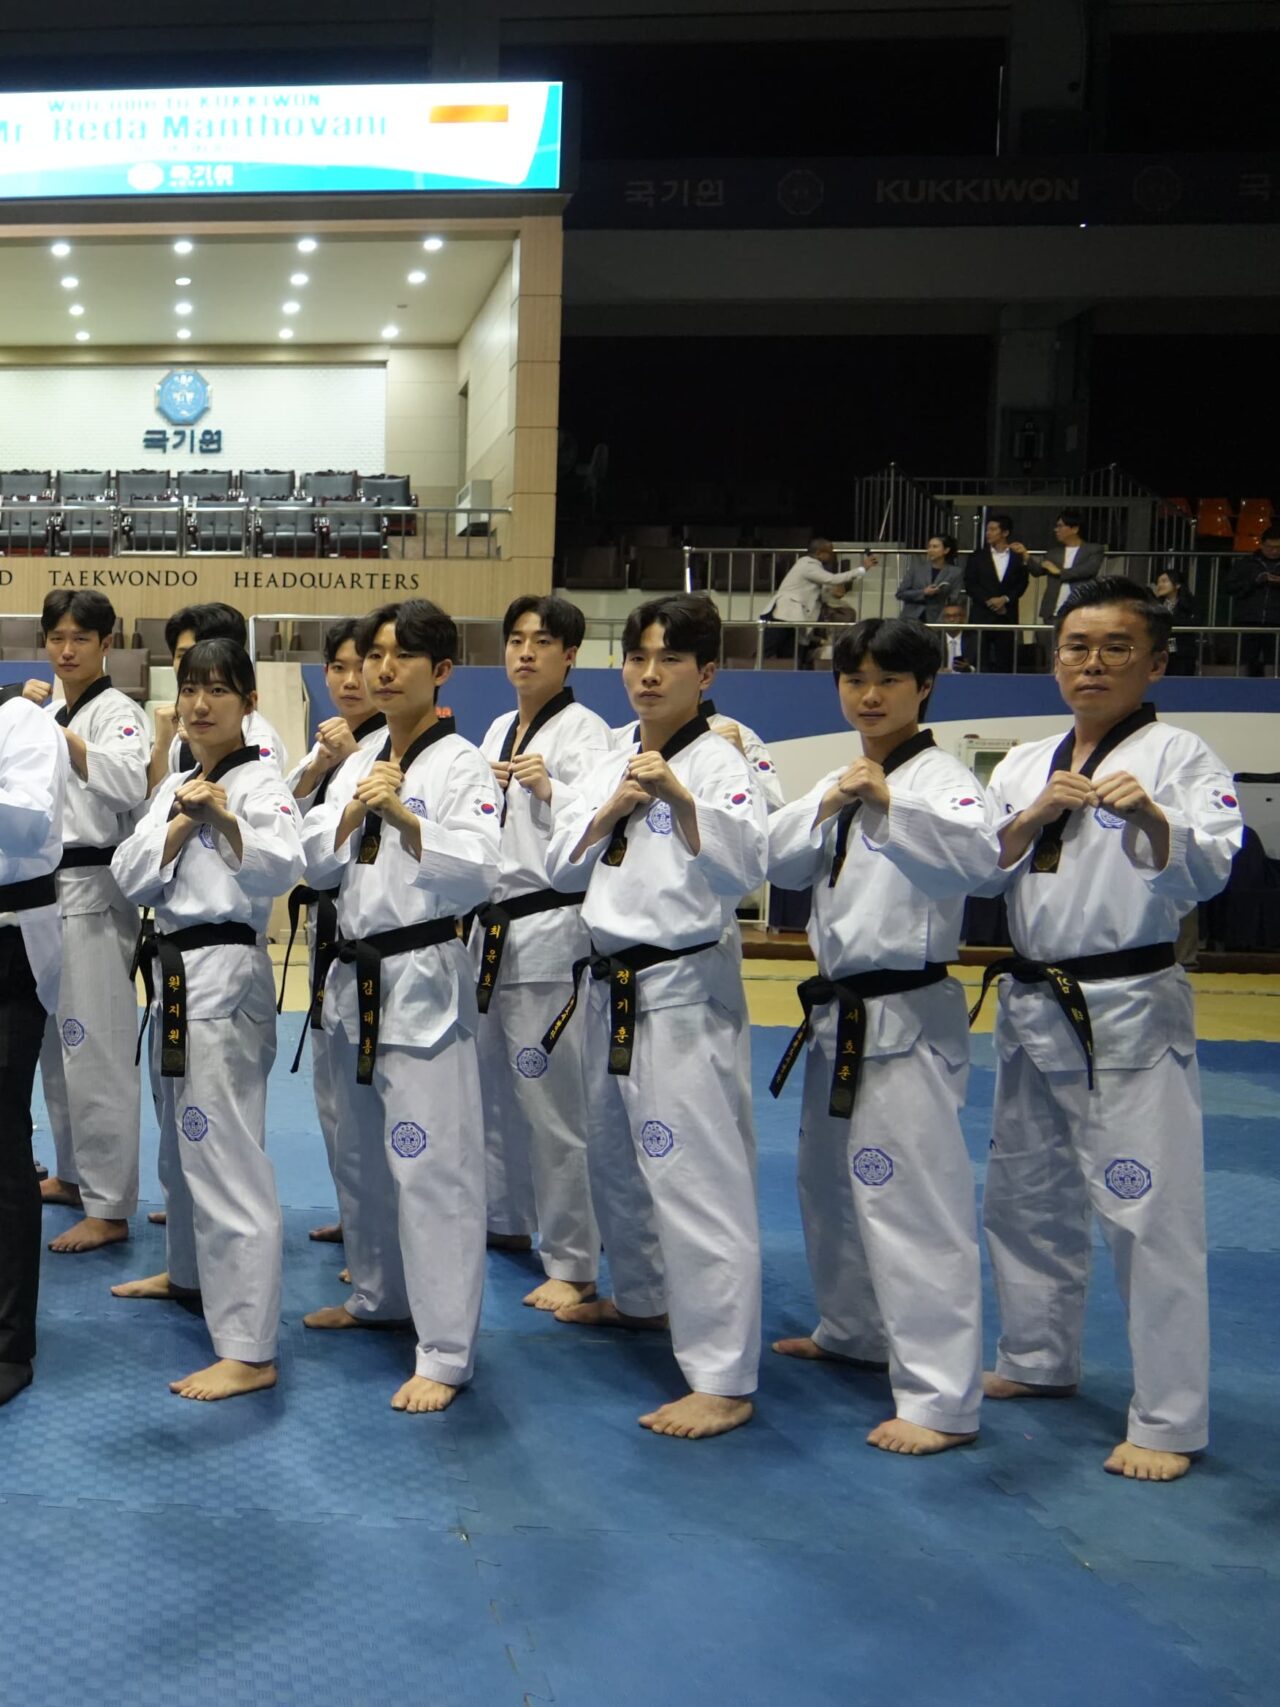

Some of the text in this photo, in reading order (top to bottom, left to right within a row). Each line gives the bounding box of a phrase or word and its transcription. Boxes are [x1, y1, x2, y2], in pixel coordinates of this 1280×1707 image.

[625, 178, 726, 209] 국기원
[875, 178, 1080, 204] KUKKIWON
[143, 429, 222, 454] 국기원
[48, 569, 198, 588] TAEKWONDO
[233, 570, 420, 591] HEADQUARTERS
